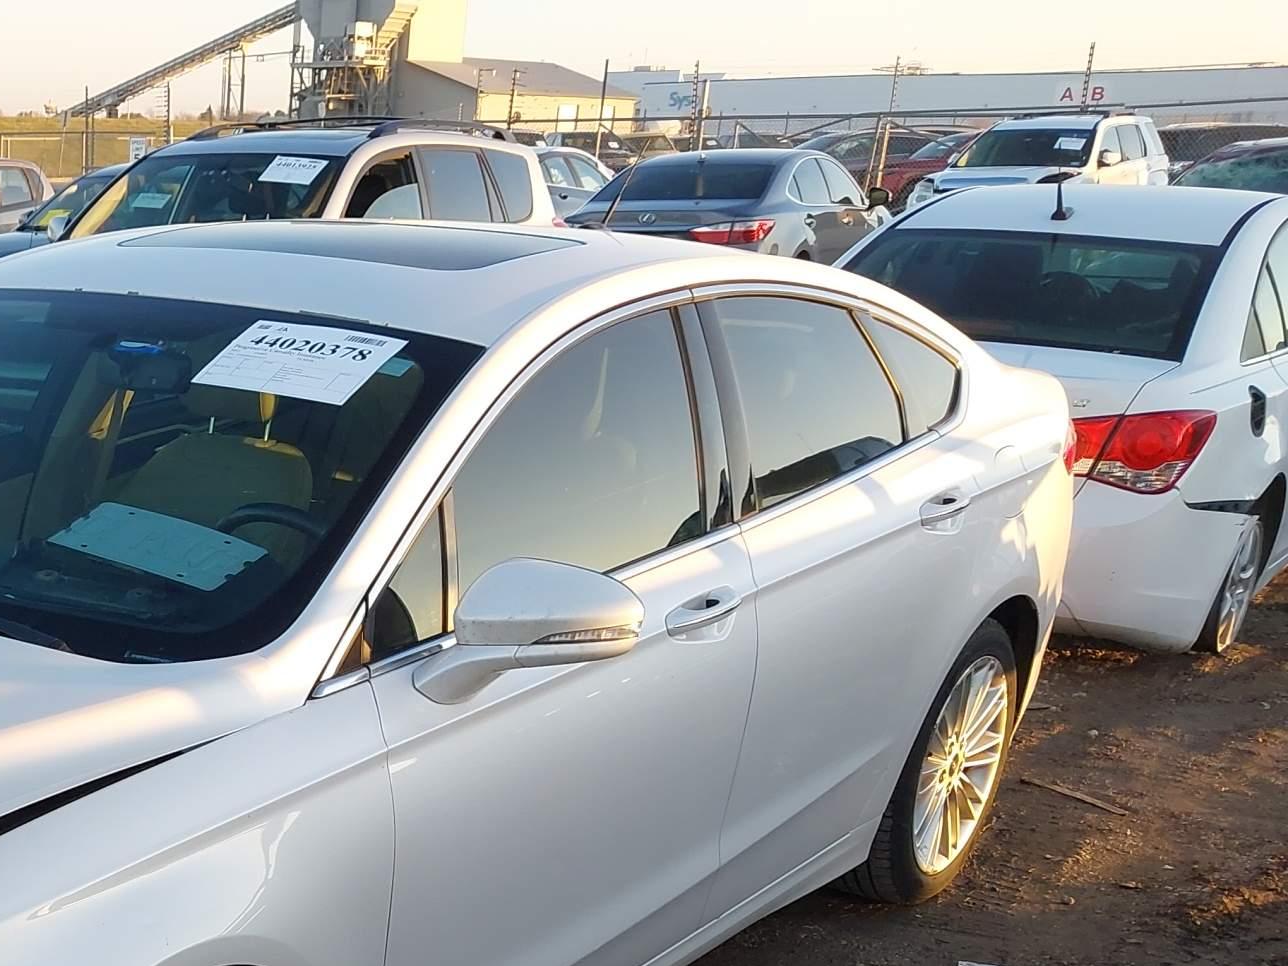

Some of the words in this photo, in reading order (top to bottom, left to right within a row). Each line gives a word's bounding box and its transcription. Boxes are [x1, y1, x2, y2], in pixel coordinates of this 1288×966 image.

[1059, 86, 1073, 102] A
[1091, 86, 1104, 102] B
[251, 334, 372, 362] 44020378
